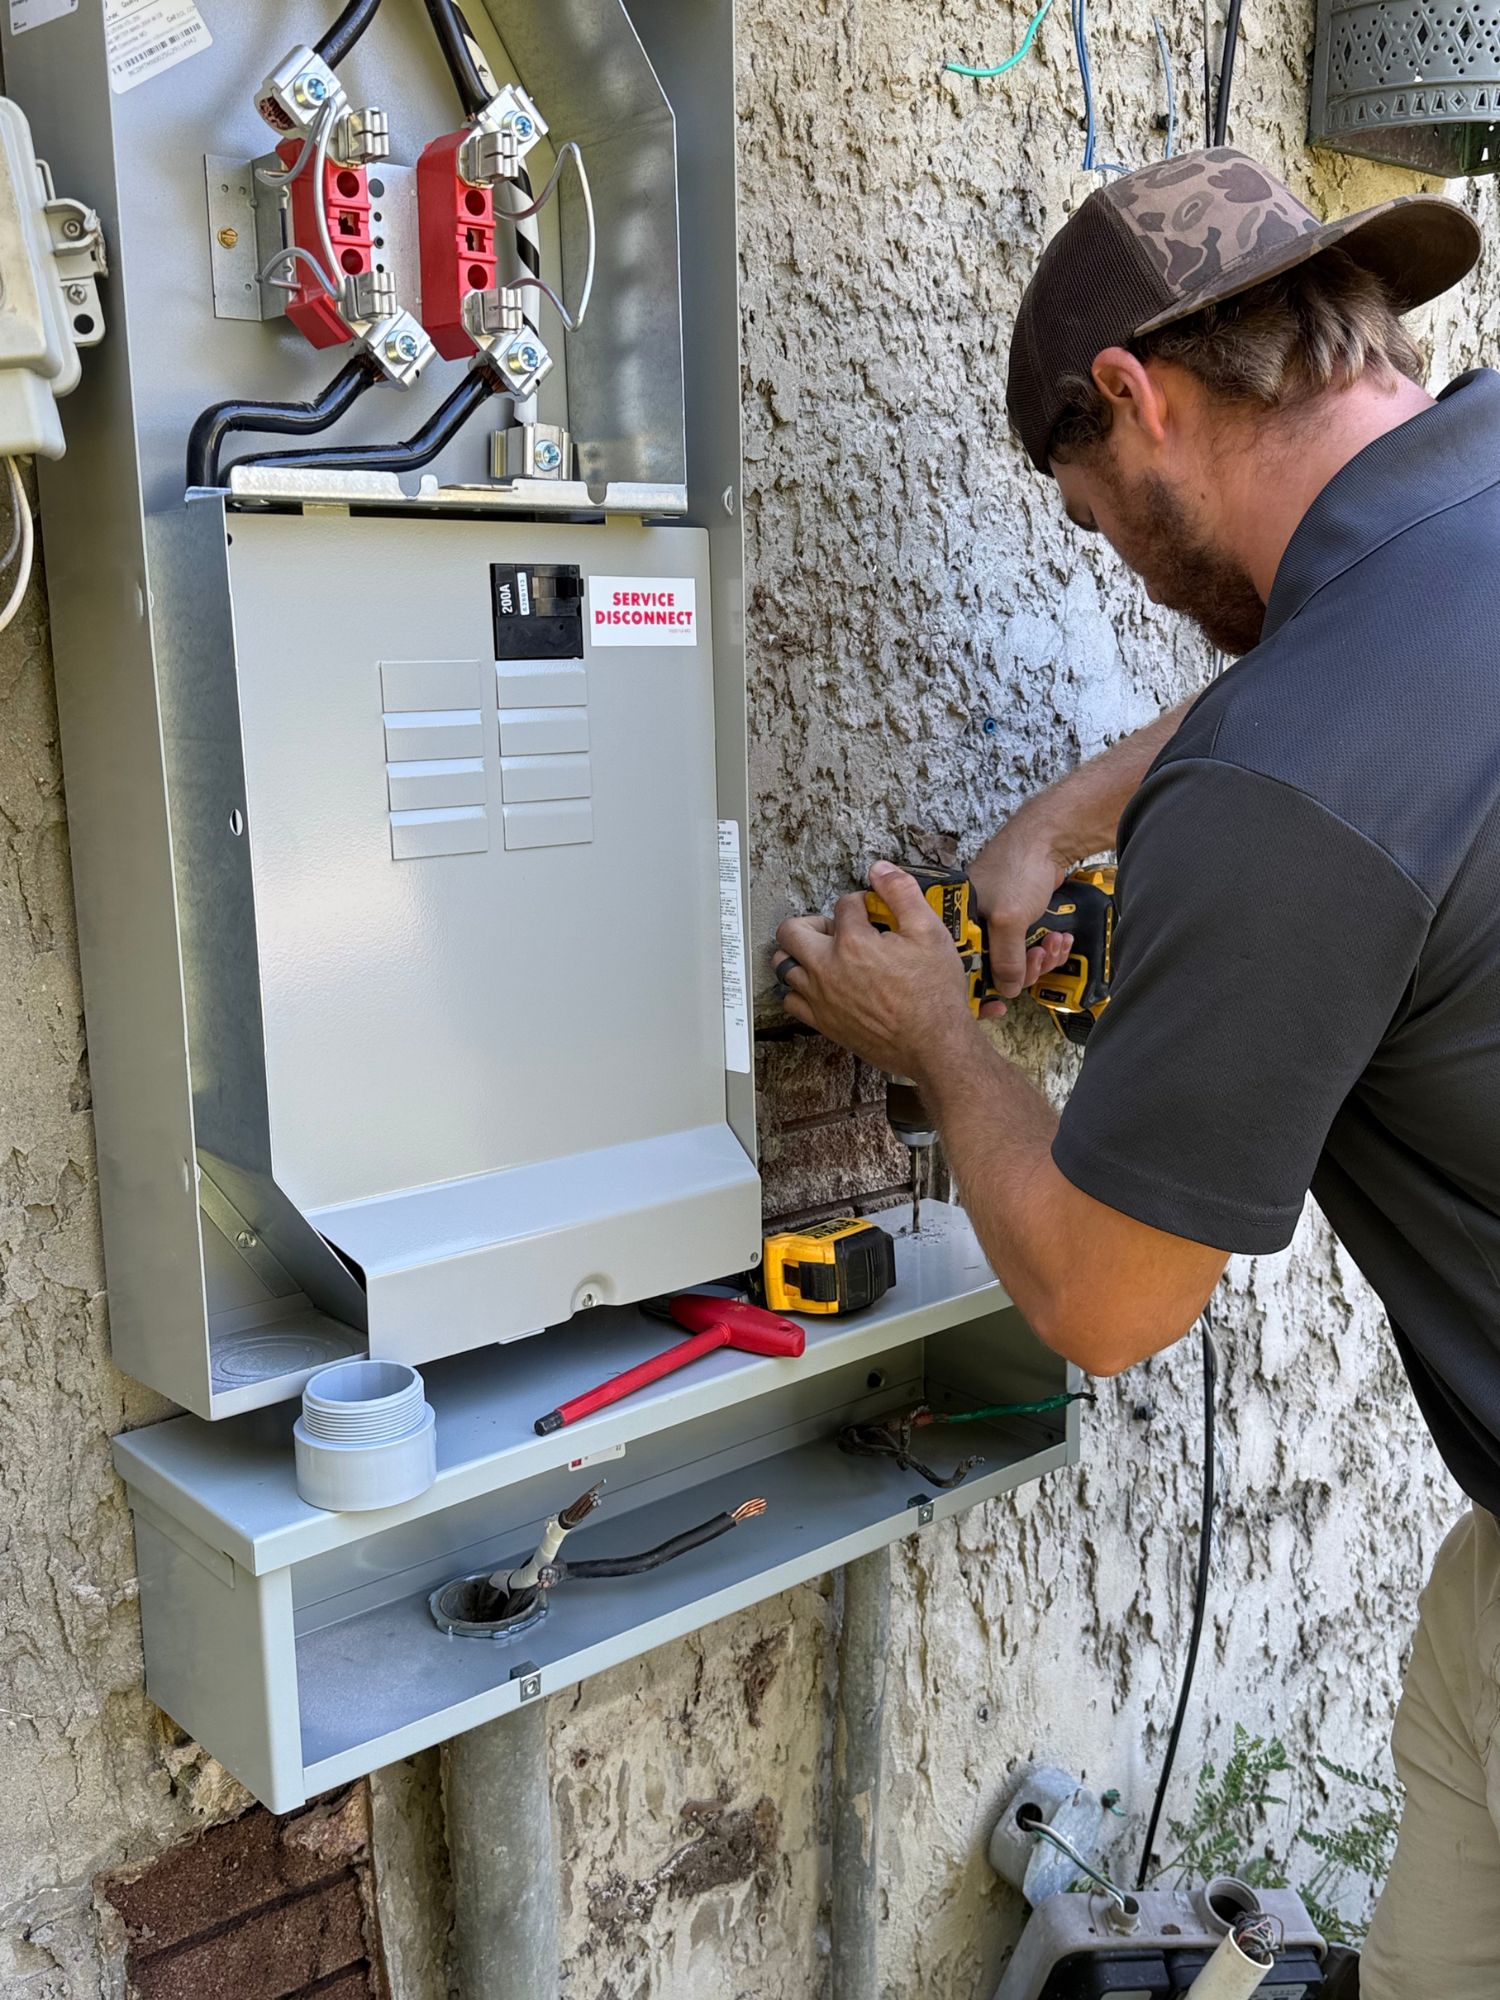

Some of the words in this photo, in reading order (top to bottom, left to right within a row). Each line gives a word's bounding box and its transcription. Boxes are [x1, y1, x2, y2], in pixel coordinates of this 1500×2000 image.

[499, 583, 513, 614] 200A
[612, 591, 675, 607] SERVICE
[595, 610, 693, 625] DISCONNECT
